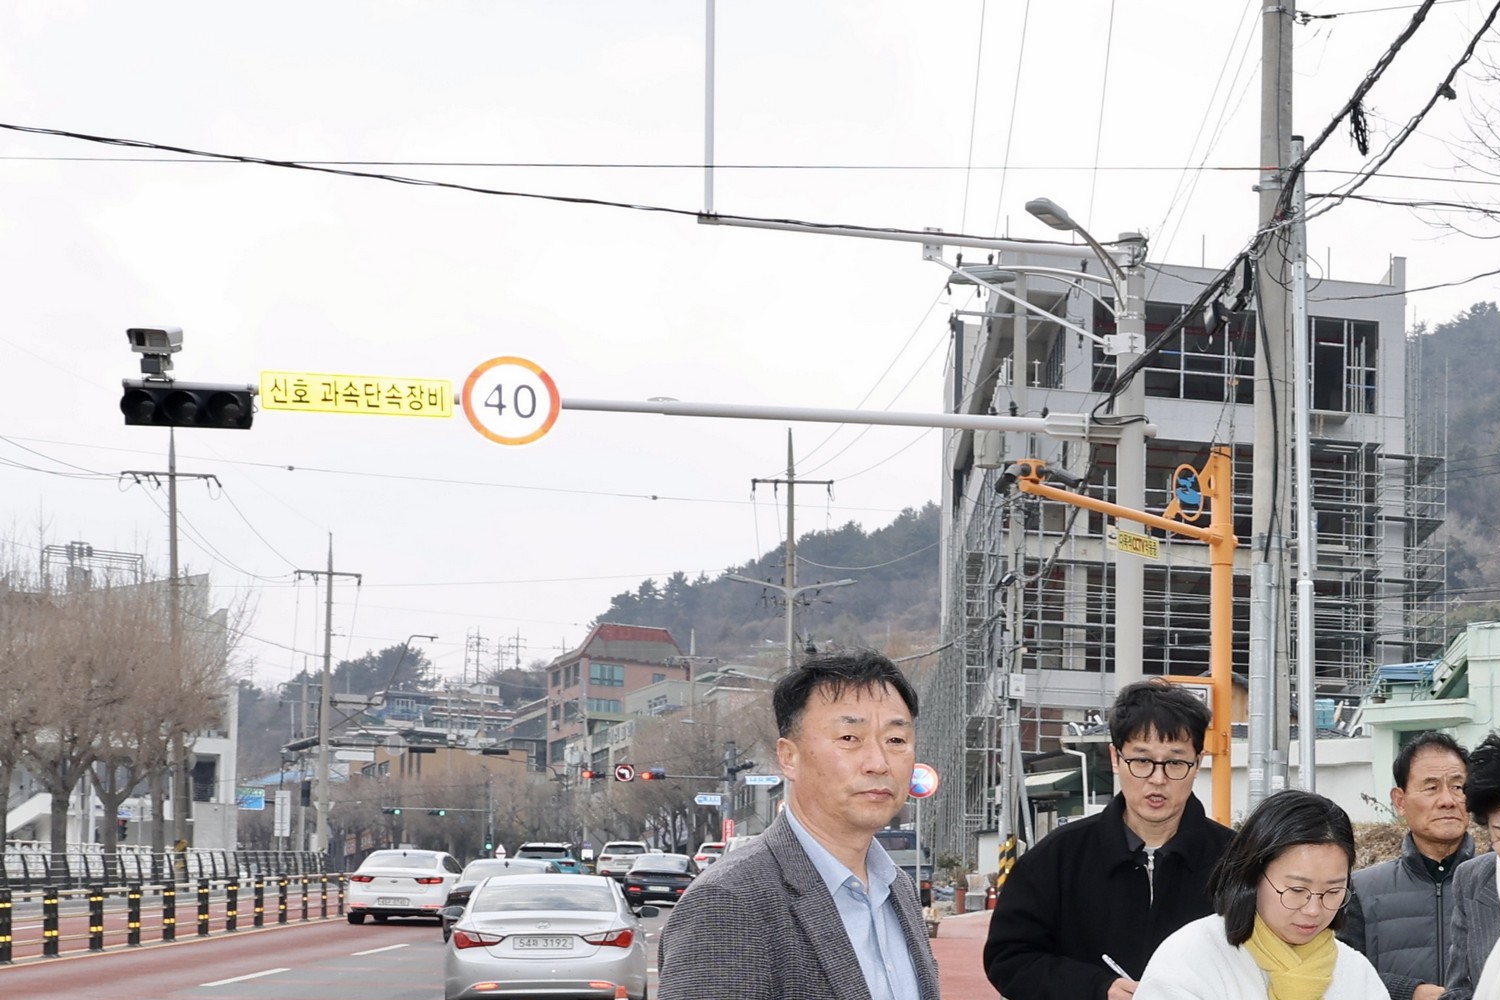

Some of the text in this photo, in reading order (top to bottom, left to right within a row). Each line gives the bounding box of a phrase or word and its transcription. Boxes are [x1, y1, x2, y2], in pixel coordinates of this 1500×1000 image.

[270, 378, 445, 412] 신호 과속단속장비
[484, 383, 537, 418] 40
[543, 938, 568, 948] 3192
